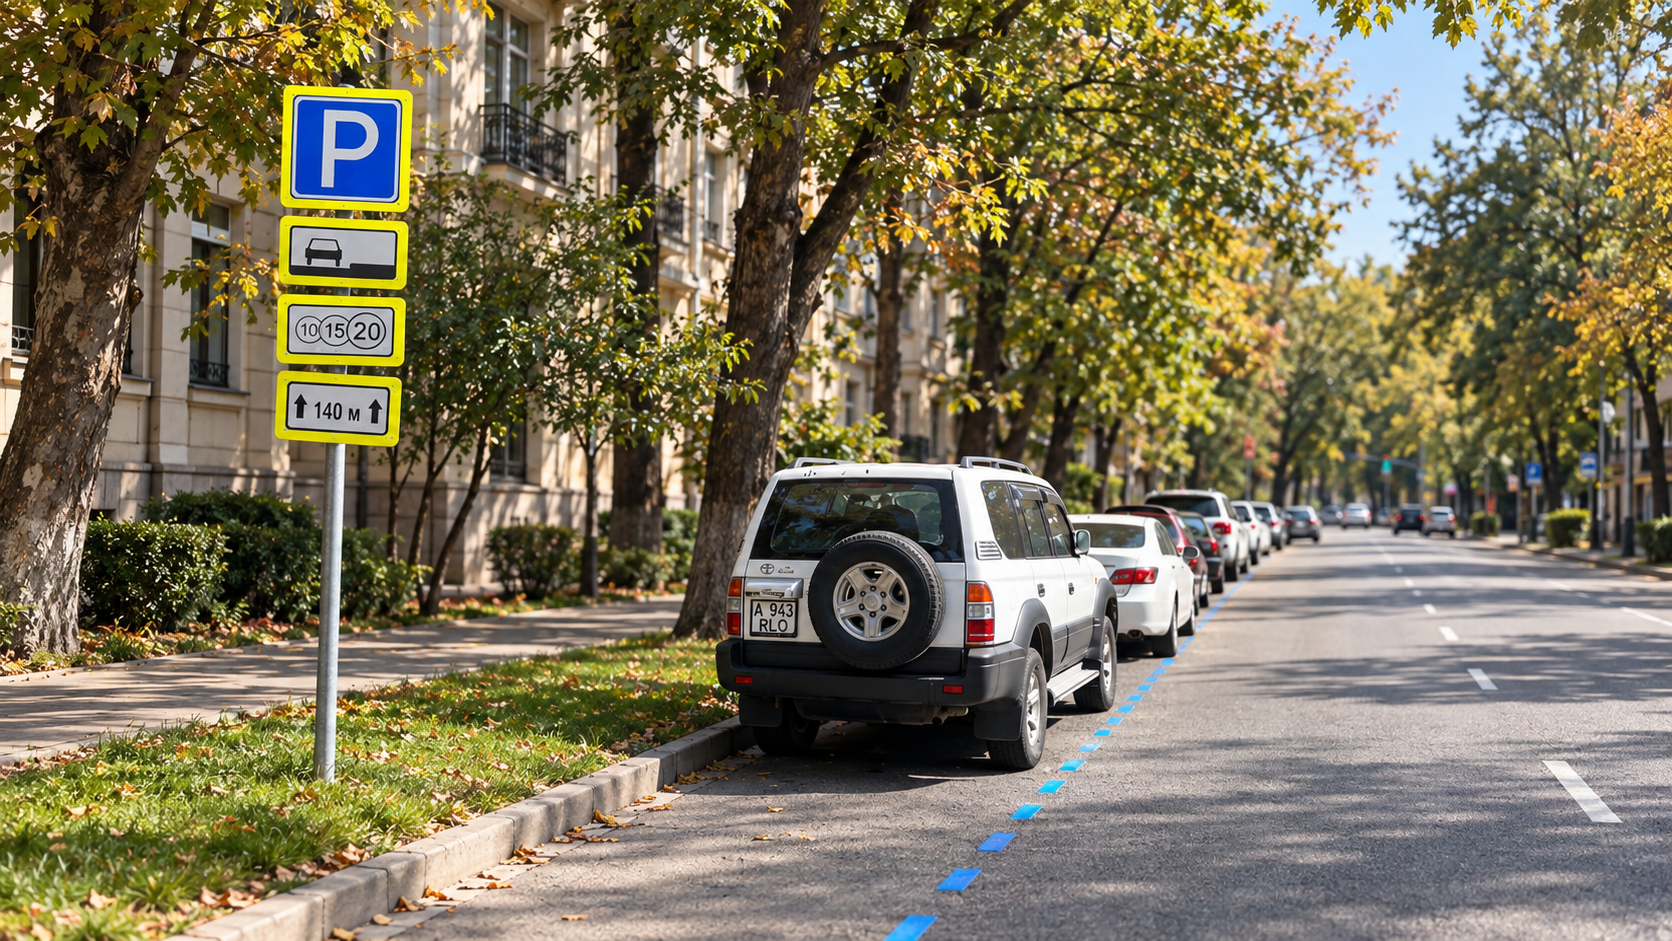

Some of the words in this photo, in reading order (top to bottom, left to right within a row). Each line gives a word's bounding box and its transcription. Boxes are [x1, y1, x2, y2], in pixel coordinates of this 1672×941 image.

[321, 109, 379, 188] P
[301, 323, 318, 337] 10
[325, 322, 345, 338] 15
[353, 322, 380, 341] 20
[314, 401, 343, 420] 140
[754, 603, 763, 617] A
[769, 603, 794, 617] 943
[760, 618, 788, 632] RLO
